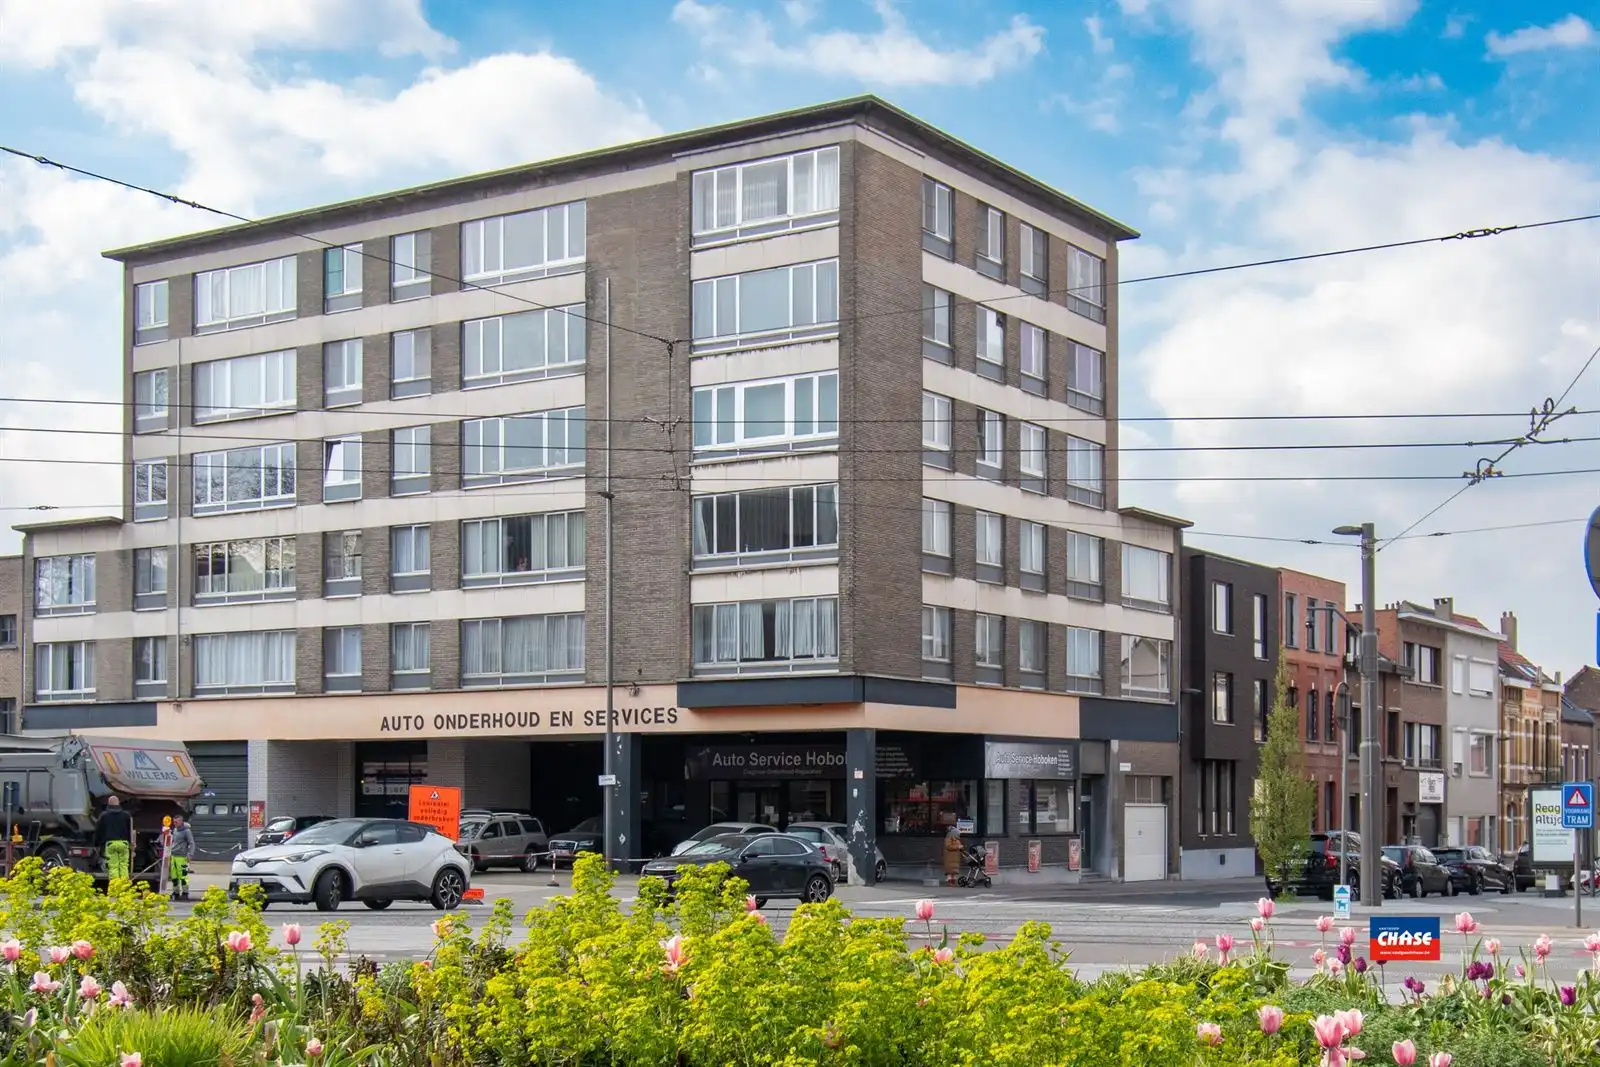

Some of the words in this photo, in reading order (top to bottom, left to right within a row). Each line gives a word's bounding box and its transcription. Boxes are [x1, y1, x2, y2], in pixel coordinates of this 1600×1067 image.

[380, 715, 425, 731] AUTO
[433, 711, 541, 729] ONDERHOUD
[550, 710, 574, 727] EN
[583, 707, 678, 727] SERVICES
[712, 752, 745, 766] Auto
[749, 752, 801, 766] Service
[1011, 751, 1033, 765] Service
[1033, 753, 1058, 765] Hoboken
[124, 770, 179, 781] WILLEMS
[1566, 815, 1589, 825] TRAM
